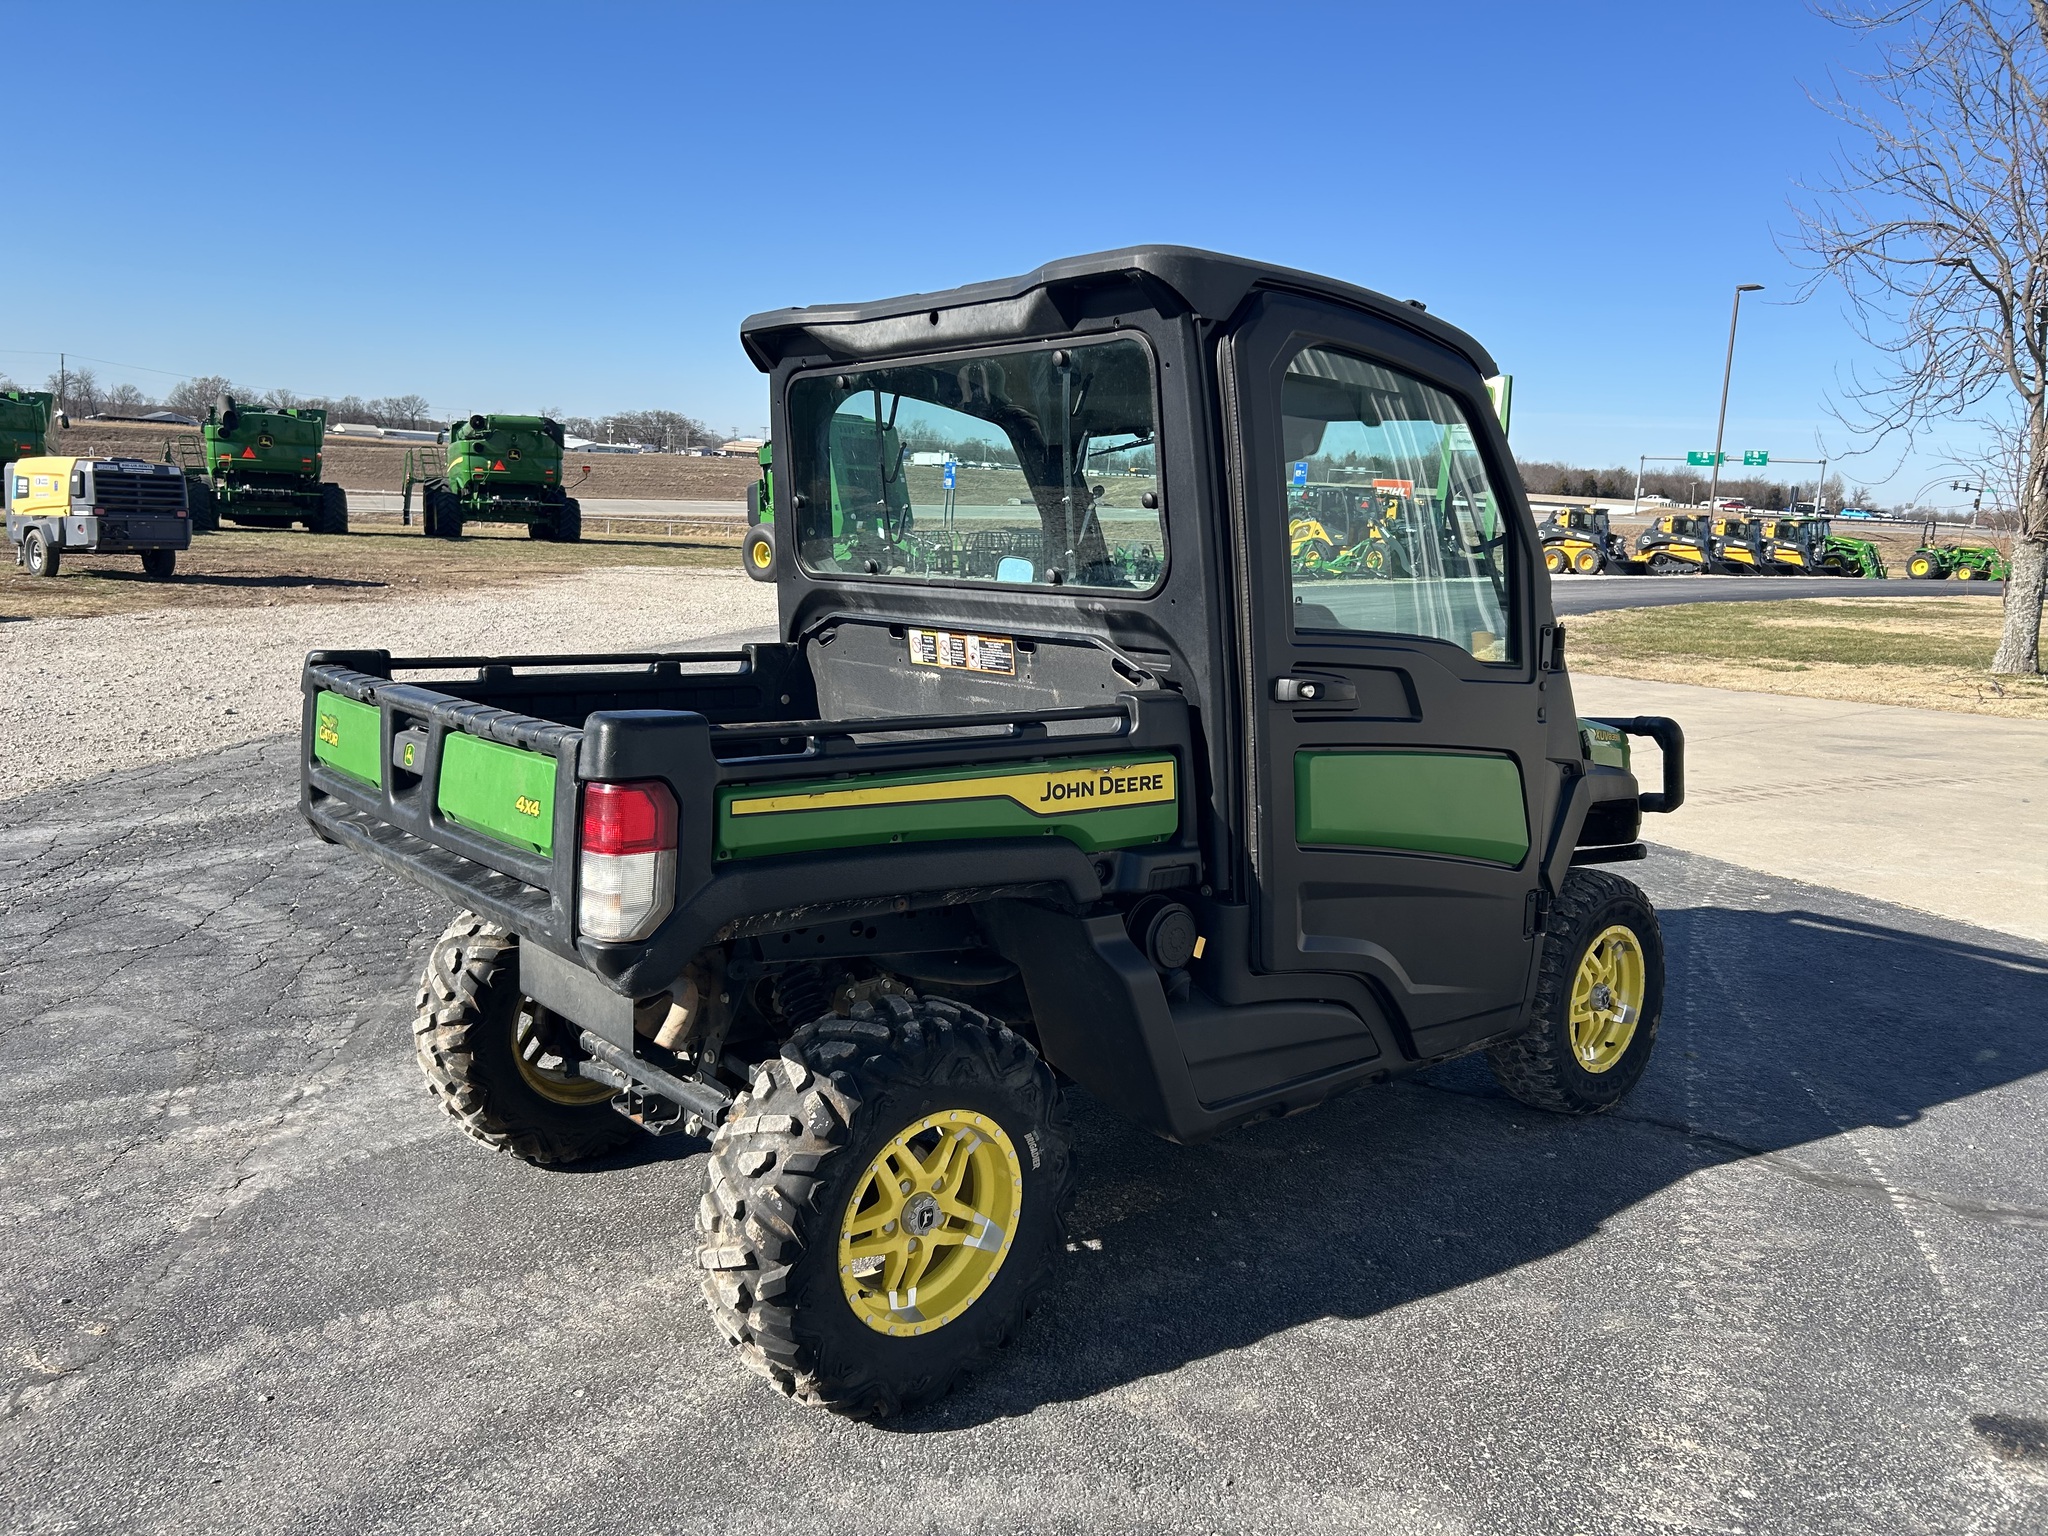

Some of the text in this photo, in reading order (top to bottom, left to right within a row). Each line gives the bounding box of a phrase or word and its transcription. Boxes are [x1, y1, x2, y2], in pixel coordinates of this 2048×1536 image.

[319, 724, 339, 748] GATOR
[1040, 774, 1163, 801] JOHN DEERE
[1023, 1132, 1041, 1171] BRIGADIER
